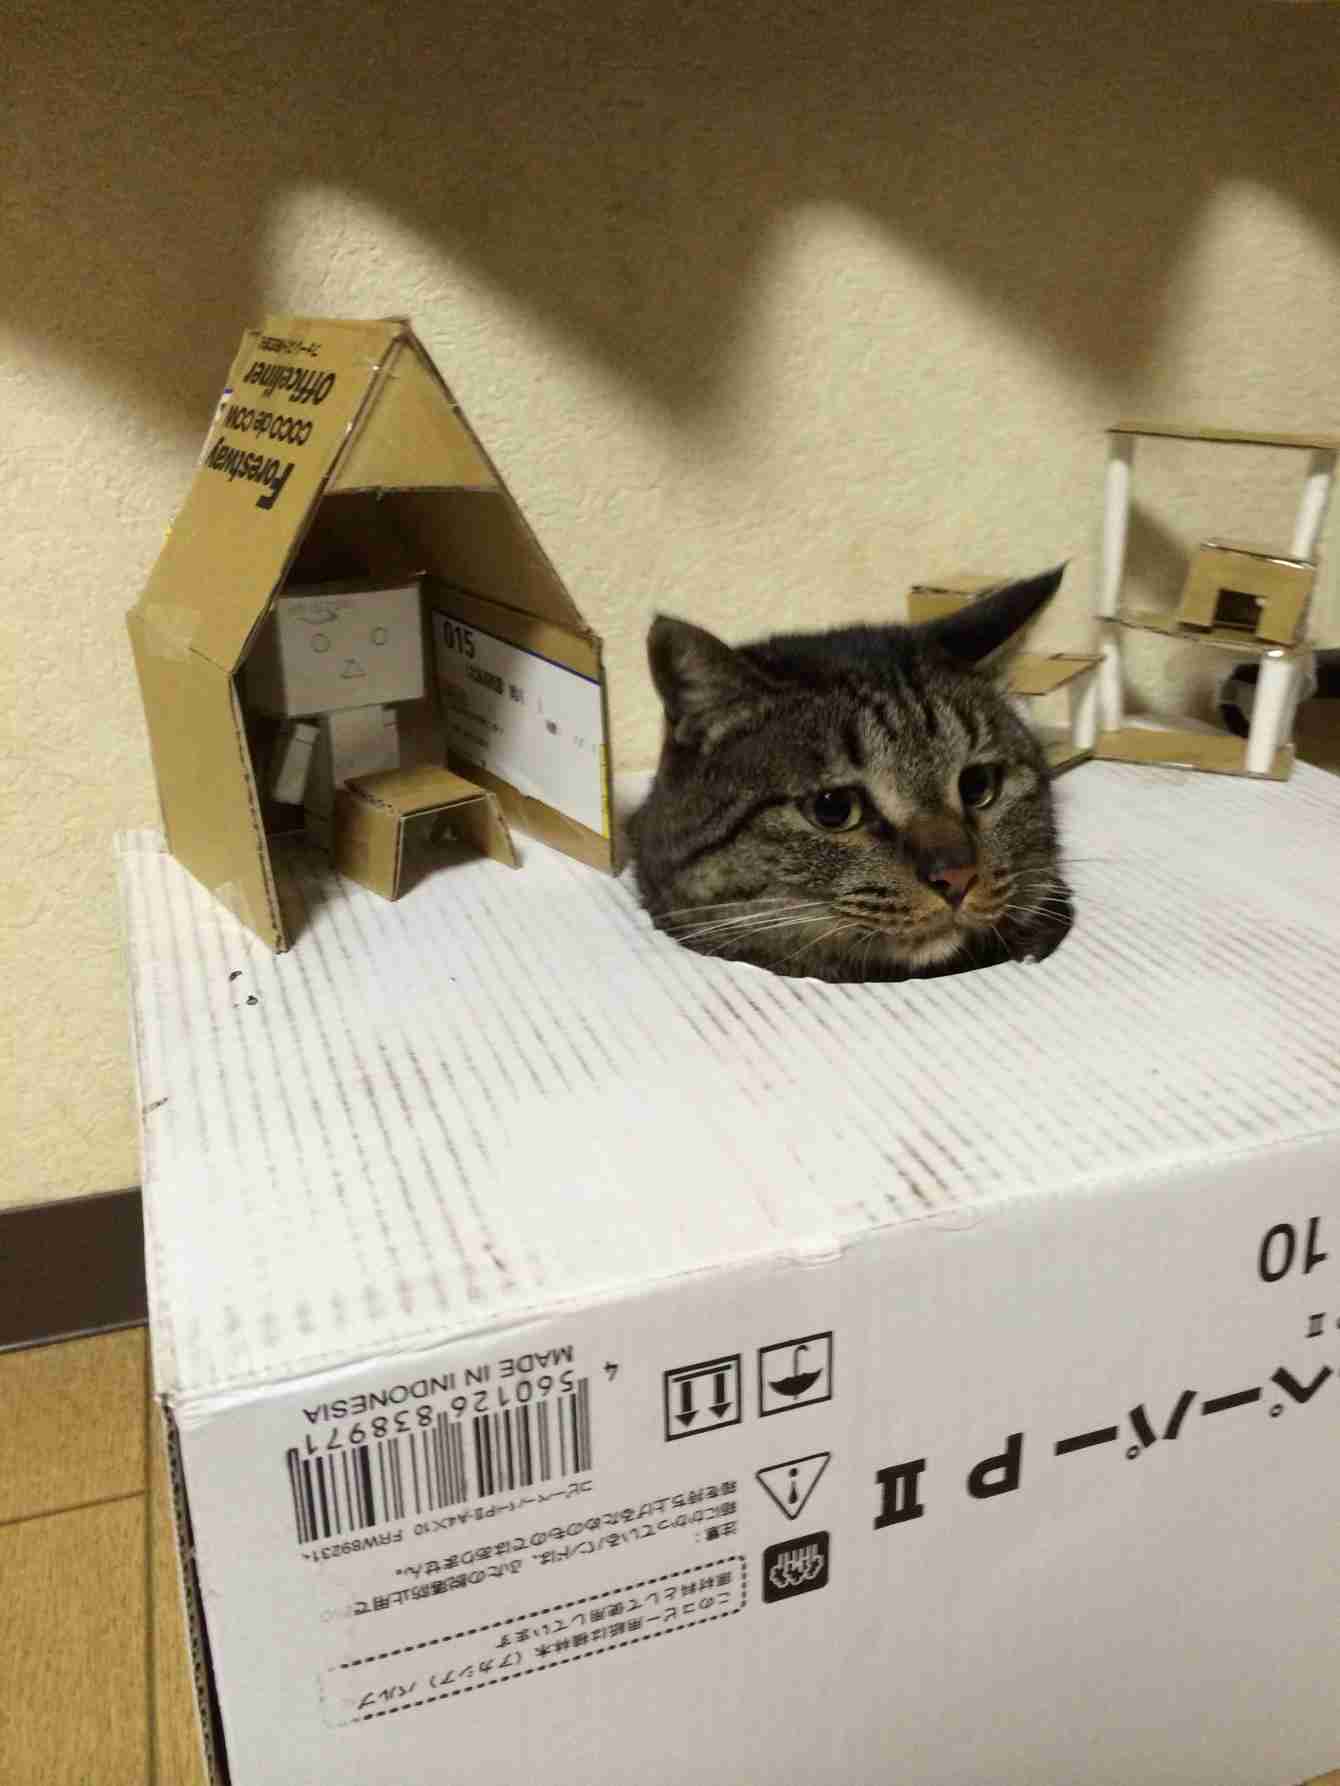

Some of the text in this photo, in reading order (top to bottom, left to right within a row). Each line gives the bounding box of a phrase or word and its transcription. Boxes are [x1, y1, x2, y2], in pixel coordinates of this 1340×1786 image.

[205, 436, 295, 511] Forestway
[1258, 1216, 1329, 1284] 10
[302, 1344, 574, 1426] MADE IN INDONESIA
[303, 1360, 620, 1457] 4 560126 838971
[1053, 1366, 1340, 1461] ペーパー
[967, 1432, 1024, 1500] P
